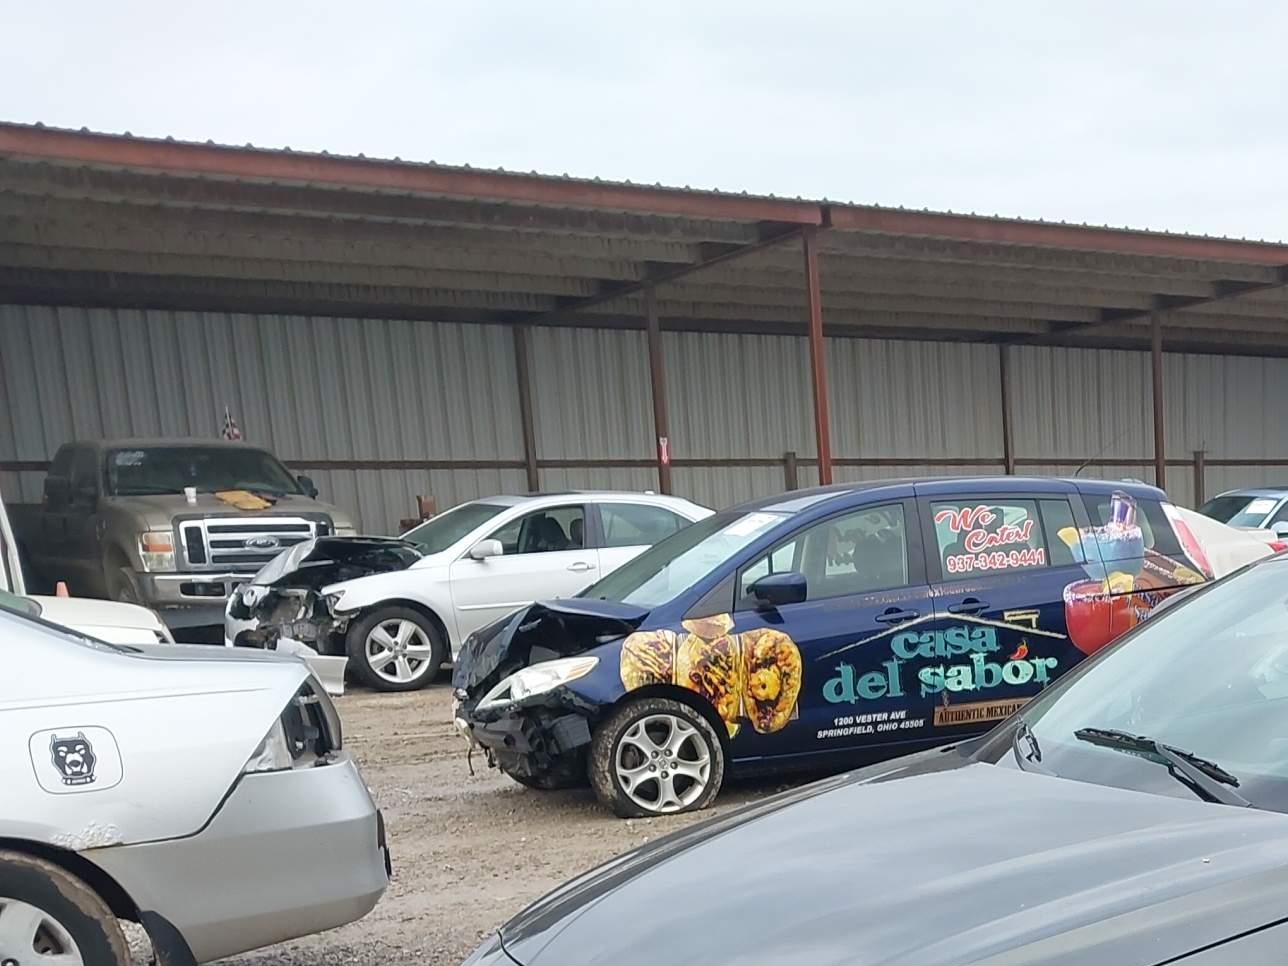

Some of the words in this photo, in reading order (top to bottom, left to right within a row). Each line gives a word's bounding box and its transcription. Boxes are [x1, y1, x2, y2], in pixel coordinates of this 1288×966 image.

[935, 505, 996, 532] We
[947, 548, 1045, 573] 937-342-9441
[890, 625, 1000, 659] casa
[822, 657, 906, 704] del
[833, 717, 854, 727] 1200
[890, 710, 907, 720] AVE
[939, 708, 984, 723] AUTHENTIC
[817, 725, 875, 739] SPRINGFIELD,
[877, 723, 898, 732] OHIO
